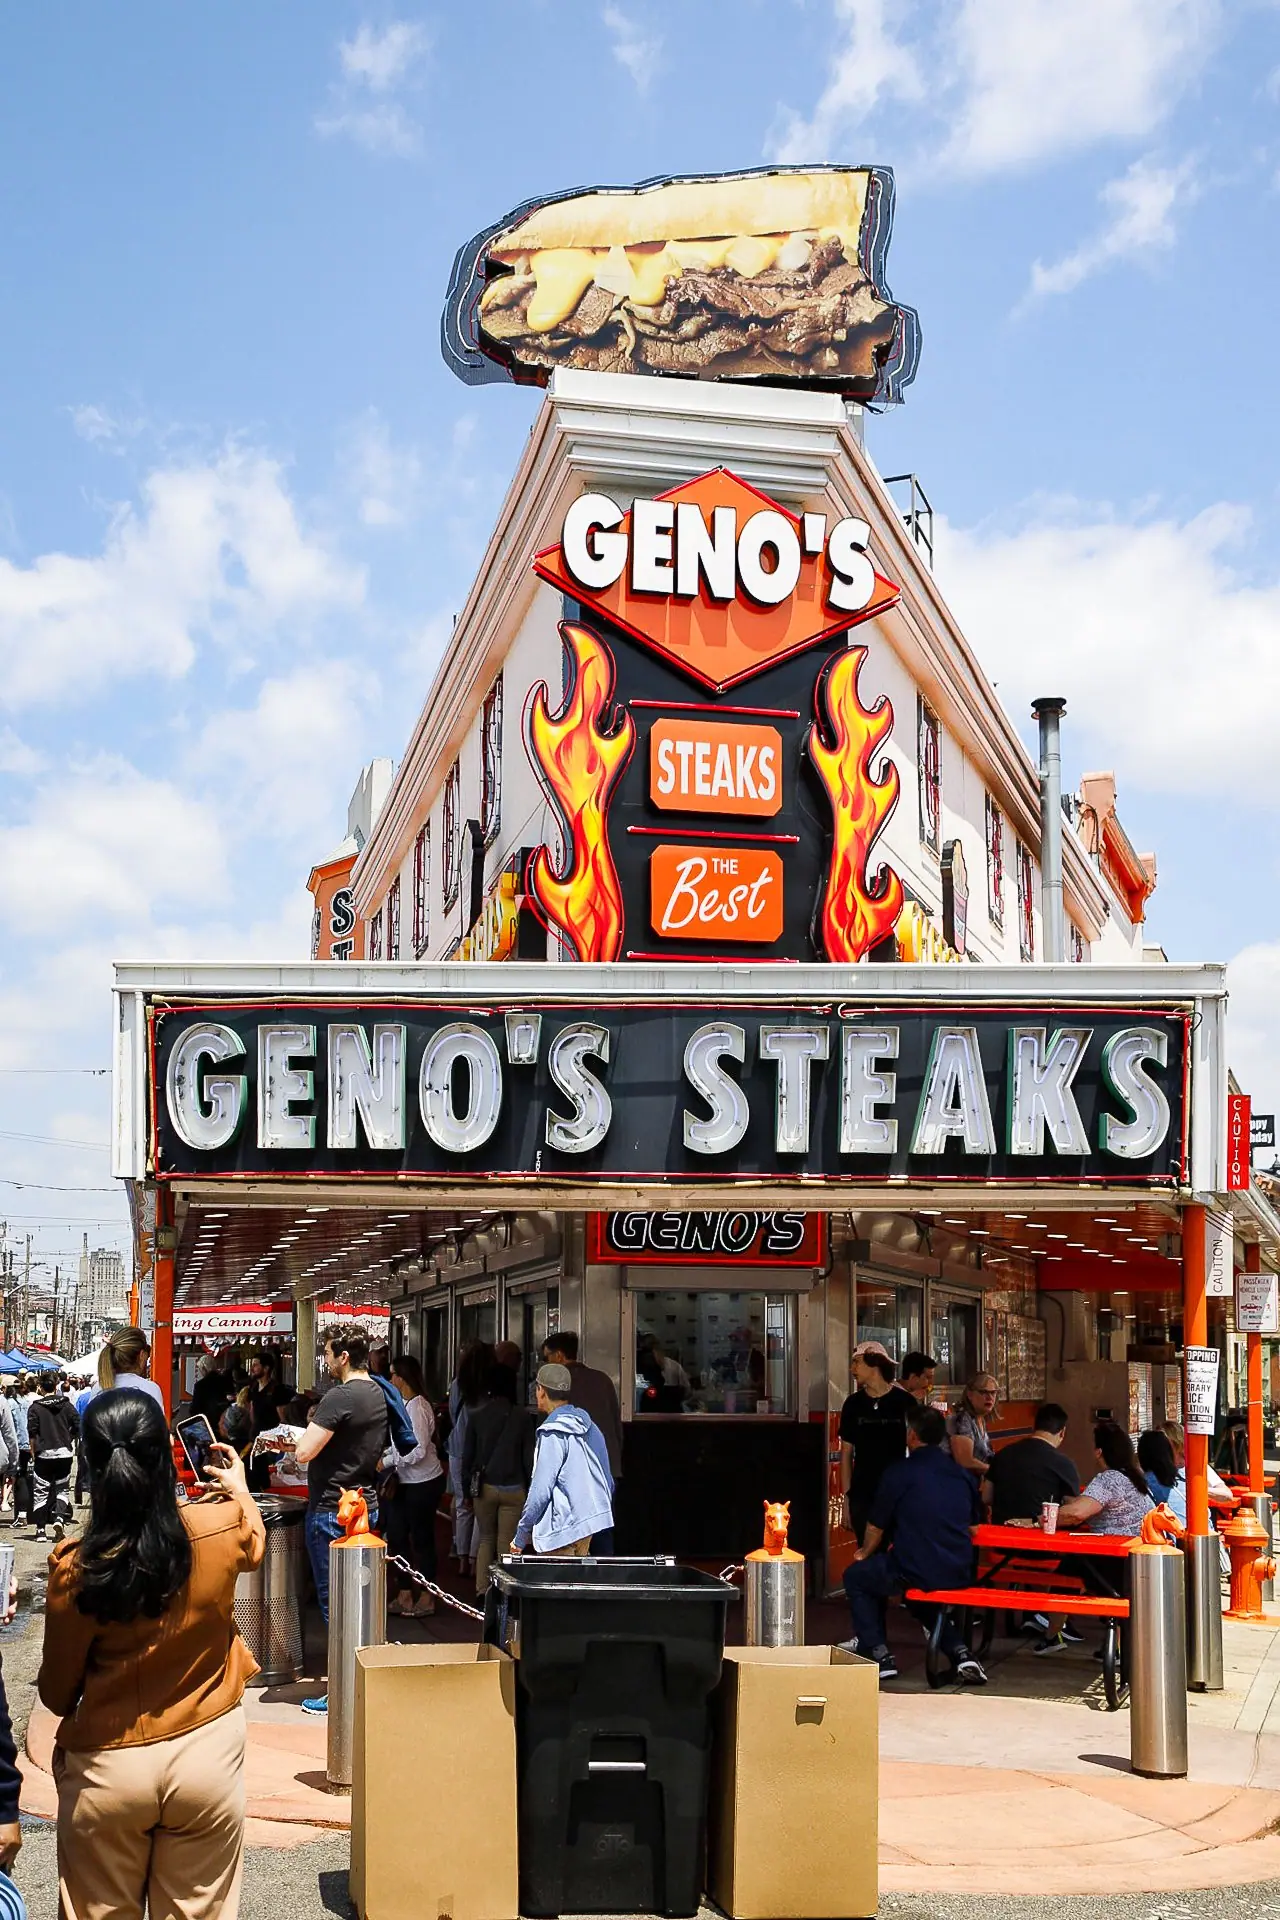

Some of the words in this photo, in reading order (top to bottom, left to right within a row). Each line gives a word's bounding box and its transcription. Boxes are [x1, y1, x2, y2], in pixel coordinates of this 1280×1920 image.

[562, 492, 876, 612] GENO'S
[657, 738, 776, 801] STEAKS
[661, 856, 773, 931] Best
[712, 857, 739, 875] THE
[166, 1013, 612, 1154] GENO'S
[683, 1021, 1172, 1159] STEAKS
[1231, 1099, 1242, 1186] CAUTION
[609, 1211, 807, 1252] GENO'S
[1212, 1238, 1223, 1293] CAUTION
[174, 1316, 203, 1331] ing
[207, 1315, 277, 1328] Cannoli
[1186, 1350, 1216, 1363] OPPING
